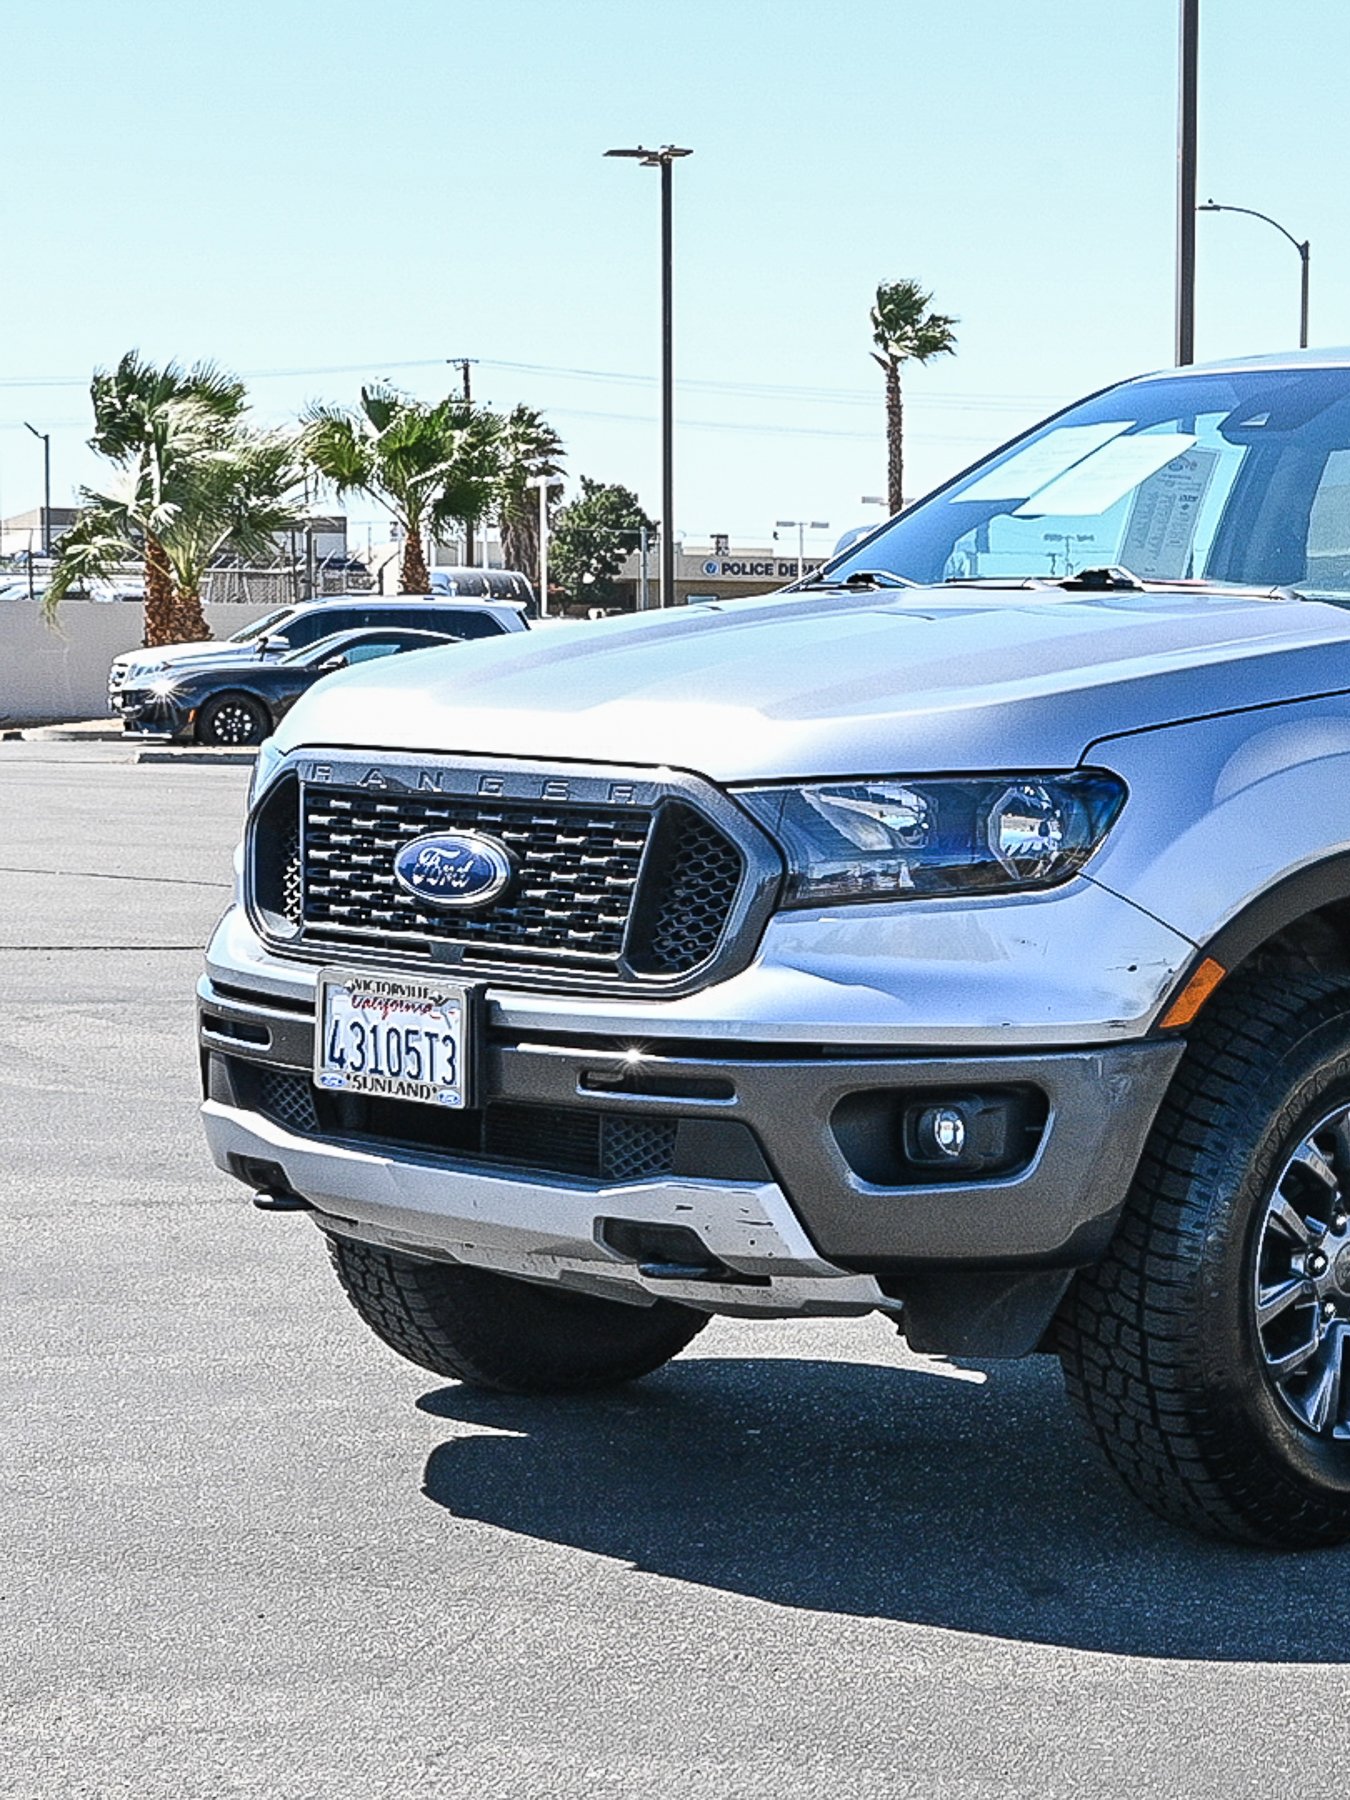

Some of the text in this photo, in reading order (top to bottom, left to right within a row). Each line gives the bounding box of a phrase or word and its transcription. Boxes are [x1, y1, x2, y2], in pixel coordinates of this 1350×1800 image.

[721, 562, 774, 576] POLICE
[309, 762, 638, 804] RANGER
[412, 847, 475, 888] Ford
[351, 994, 434, 1021] California
[328, 1019, 457, 1086] 43105T3
[352, 1075, 431, 1100] SUNLAND
